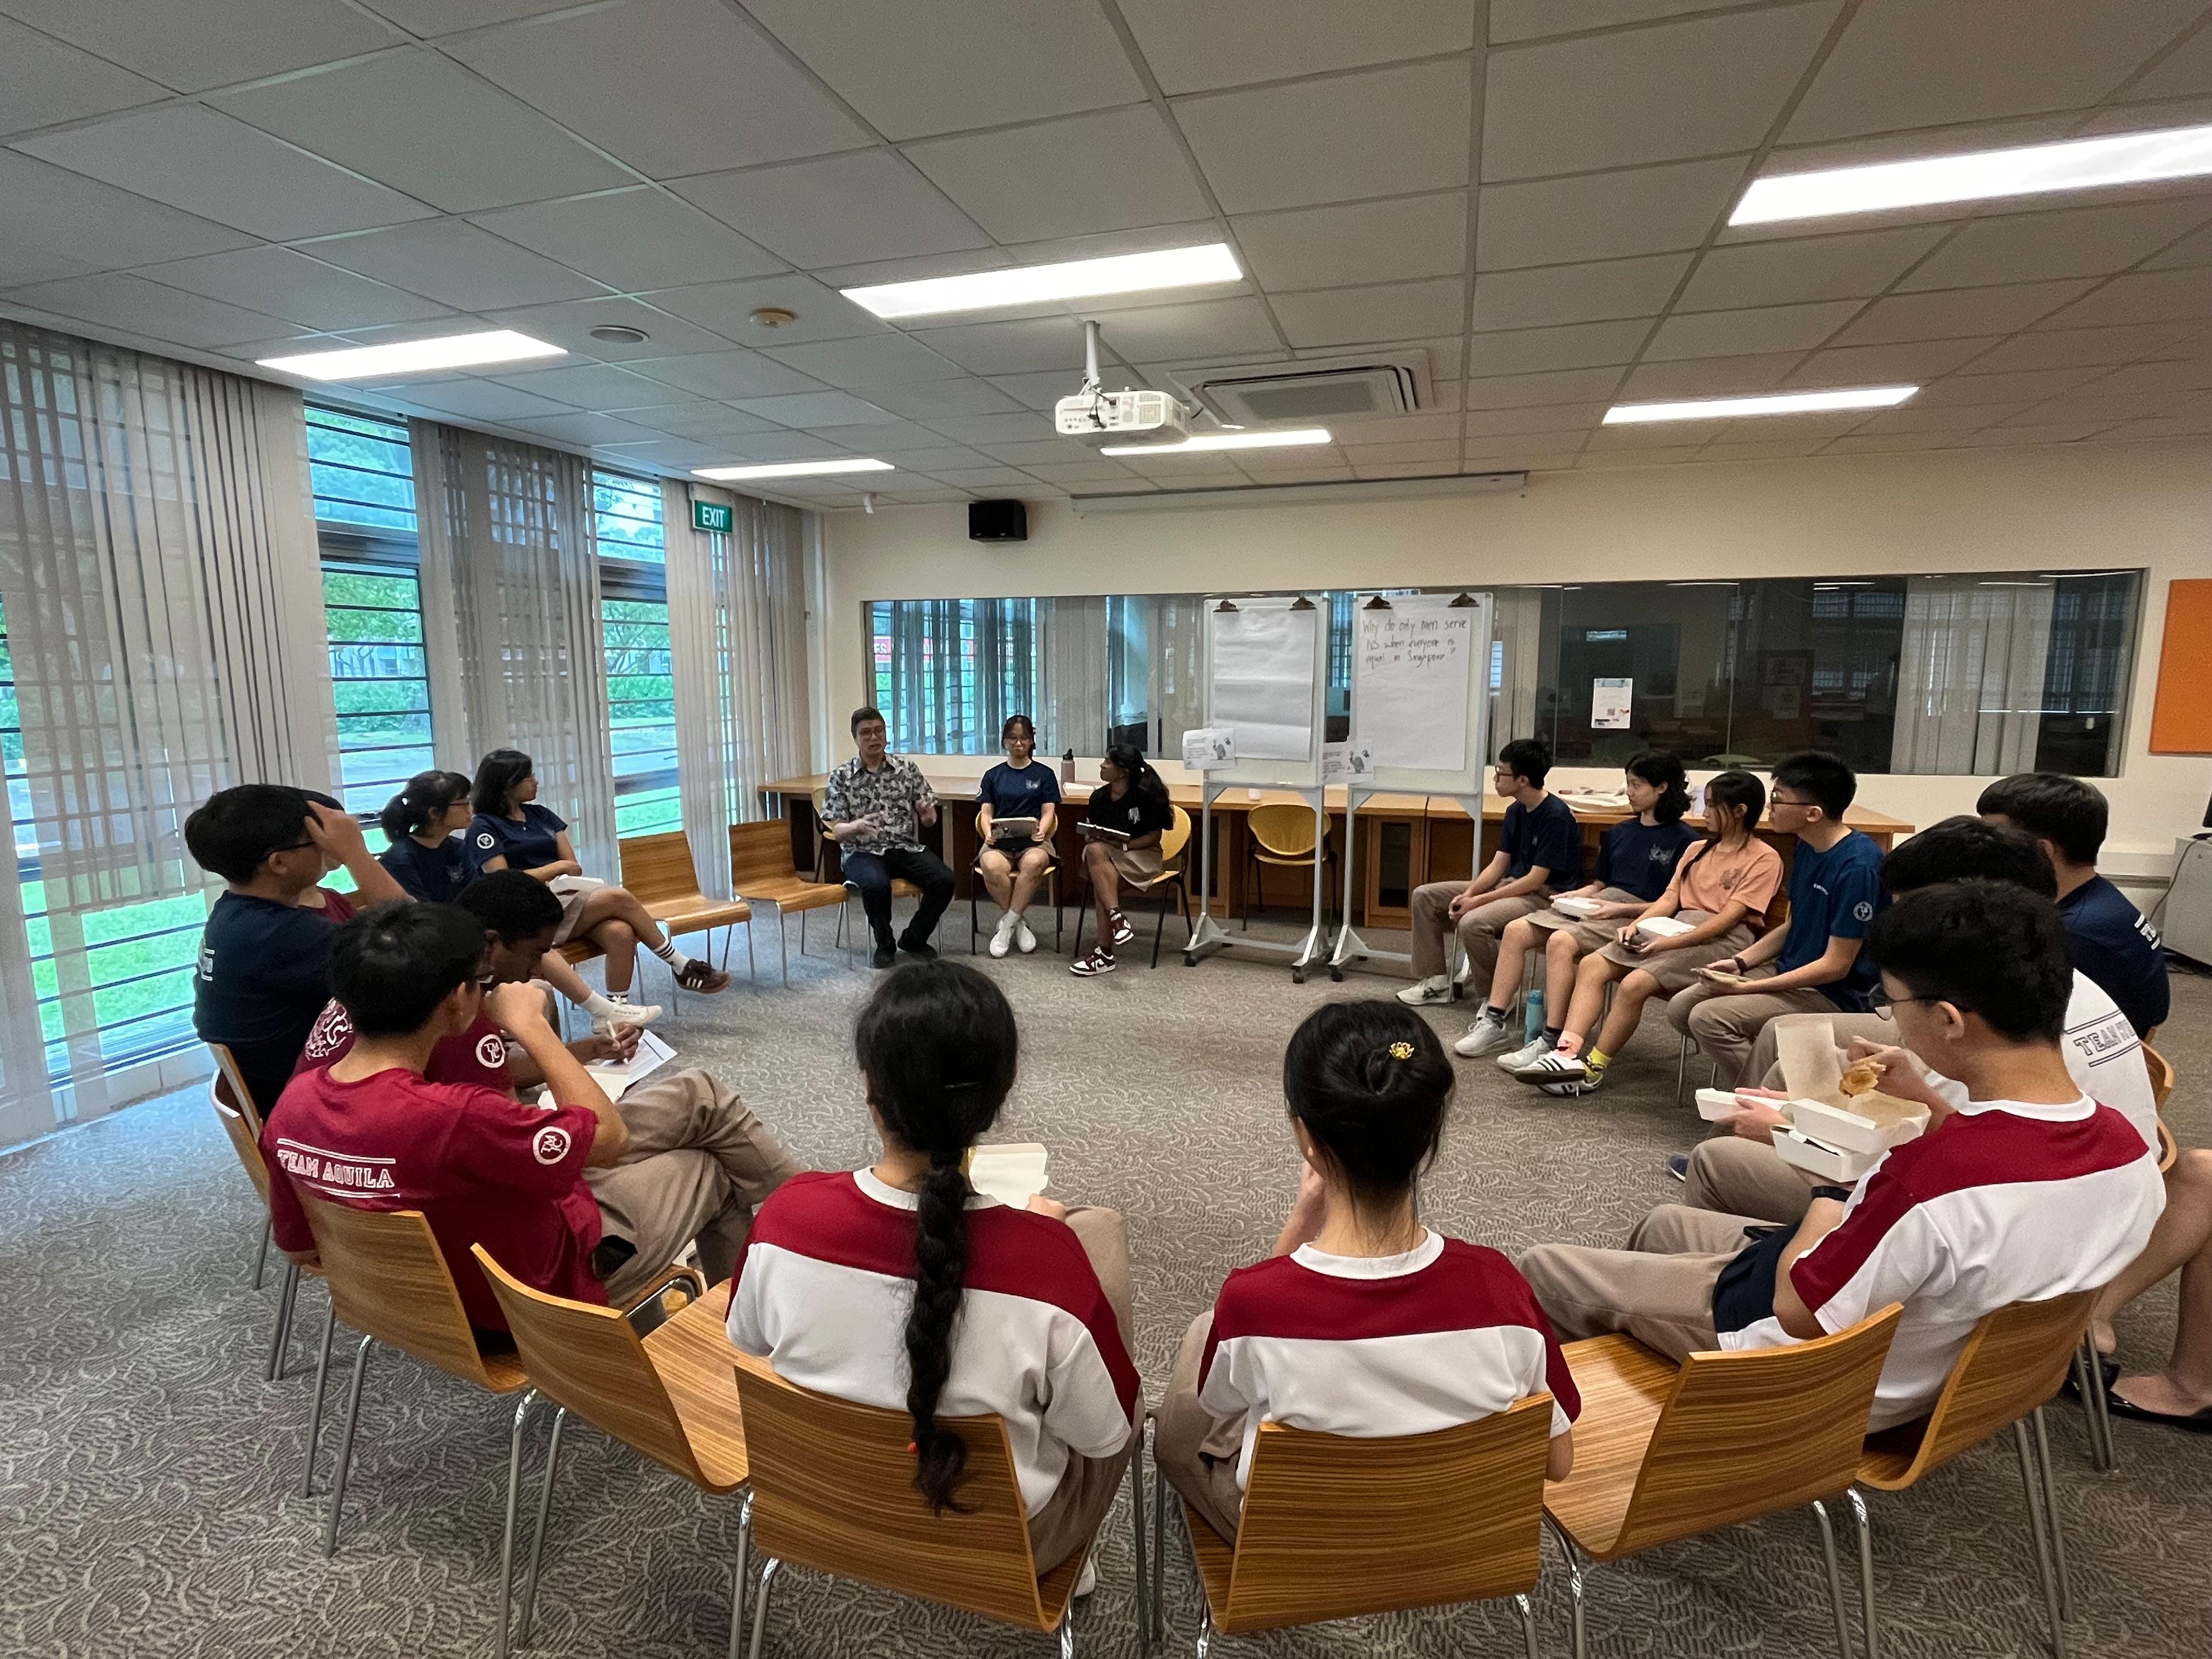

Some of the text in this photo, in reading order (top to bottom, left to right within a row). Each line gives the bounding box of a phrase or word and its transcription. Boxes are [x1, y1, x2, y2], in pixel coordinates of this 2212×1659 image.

[702, 506, 725, 528] EXIT
[1363, 618, 1466, 637] Why do only men serve
[1367, 639, 1379, 651] NS
[1385, 635, 1404, 648] when
[1408, 640, 1439, 653] everyone
[1366, 653, 1385, 669] equal
[2073, 1025, 2121, 1056] TEAM
[277, 1149, 395, 1188] TEAM AQUILA
